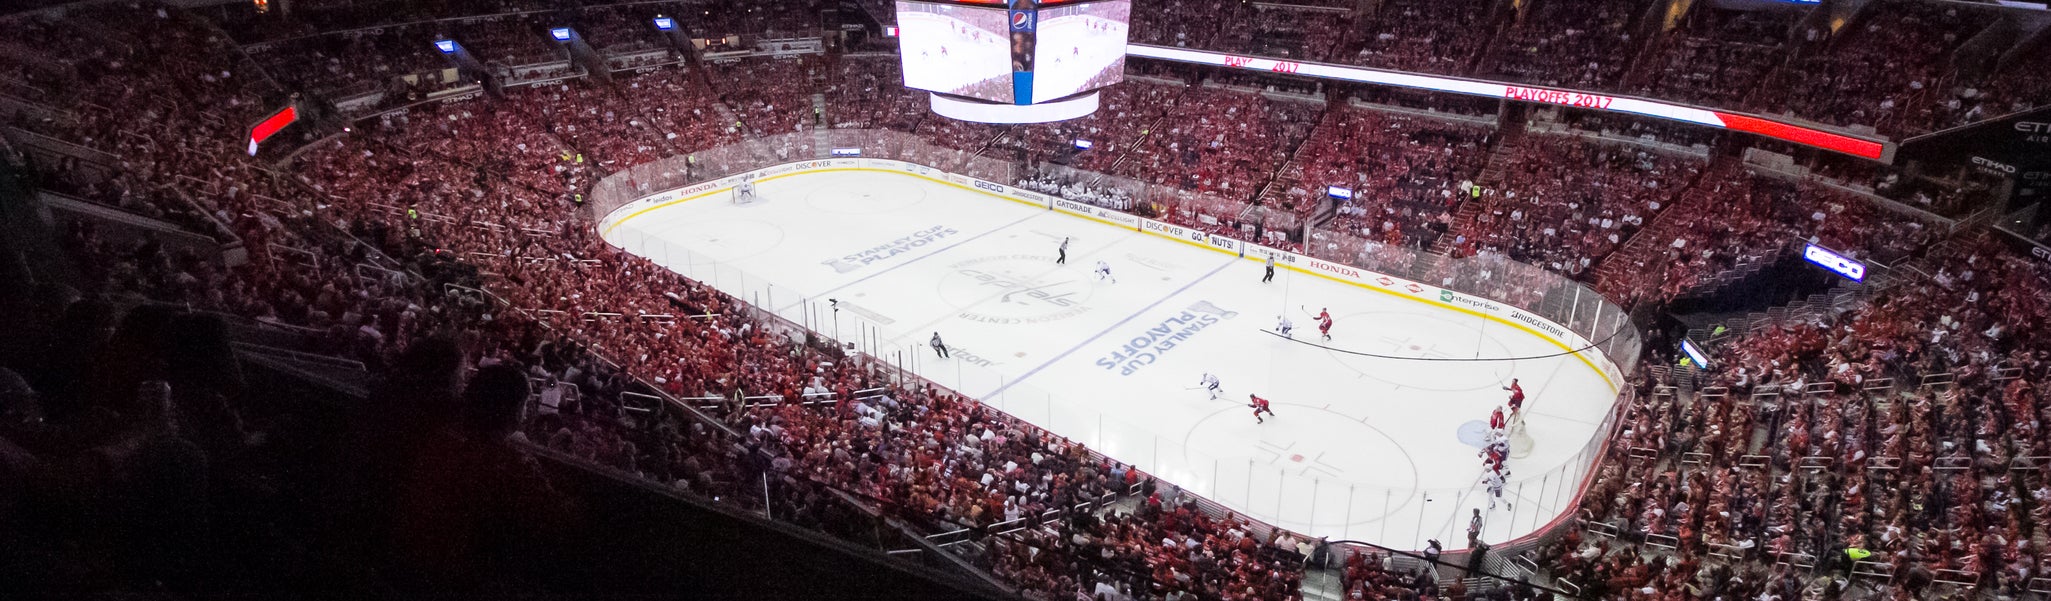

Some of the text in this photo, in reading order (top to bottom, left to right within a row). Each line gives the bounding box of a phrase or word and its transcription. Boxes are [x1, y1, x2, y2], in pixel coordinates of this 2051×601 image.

[1271, 61, 1299, 73] 2017
[1505, 86, 1613, 109] PLAYOFFS 2017
[795, 160, 832, 170] DISCOVER
[1971, 156, 2016, 173] ETIHAD
[680, 182, 718, 197] HONDA
[974, 179, 1004, 193] GEICO
[1056, 199, 1092, 214] GATORADE
[1146, 220, 1184, 237] DISCOVER
[843, 224, 944, 263] STANLEY CUP
[860, 227, 959, 266] PLAYOFFS
[1310, 261, 1361, 279] HONDA
[1444, 293, 1500, 312] enterprise
[958, 311, 1022, 325] CENTER
[1510, 310, 1566, 339] BRIDGESTONE
[1095, 310, 1197, 370] PLAYOFFS
[1120, 313, 1219, 377] STANLEY CUP
[944, 343, 992, 368] erizon
